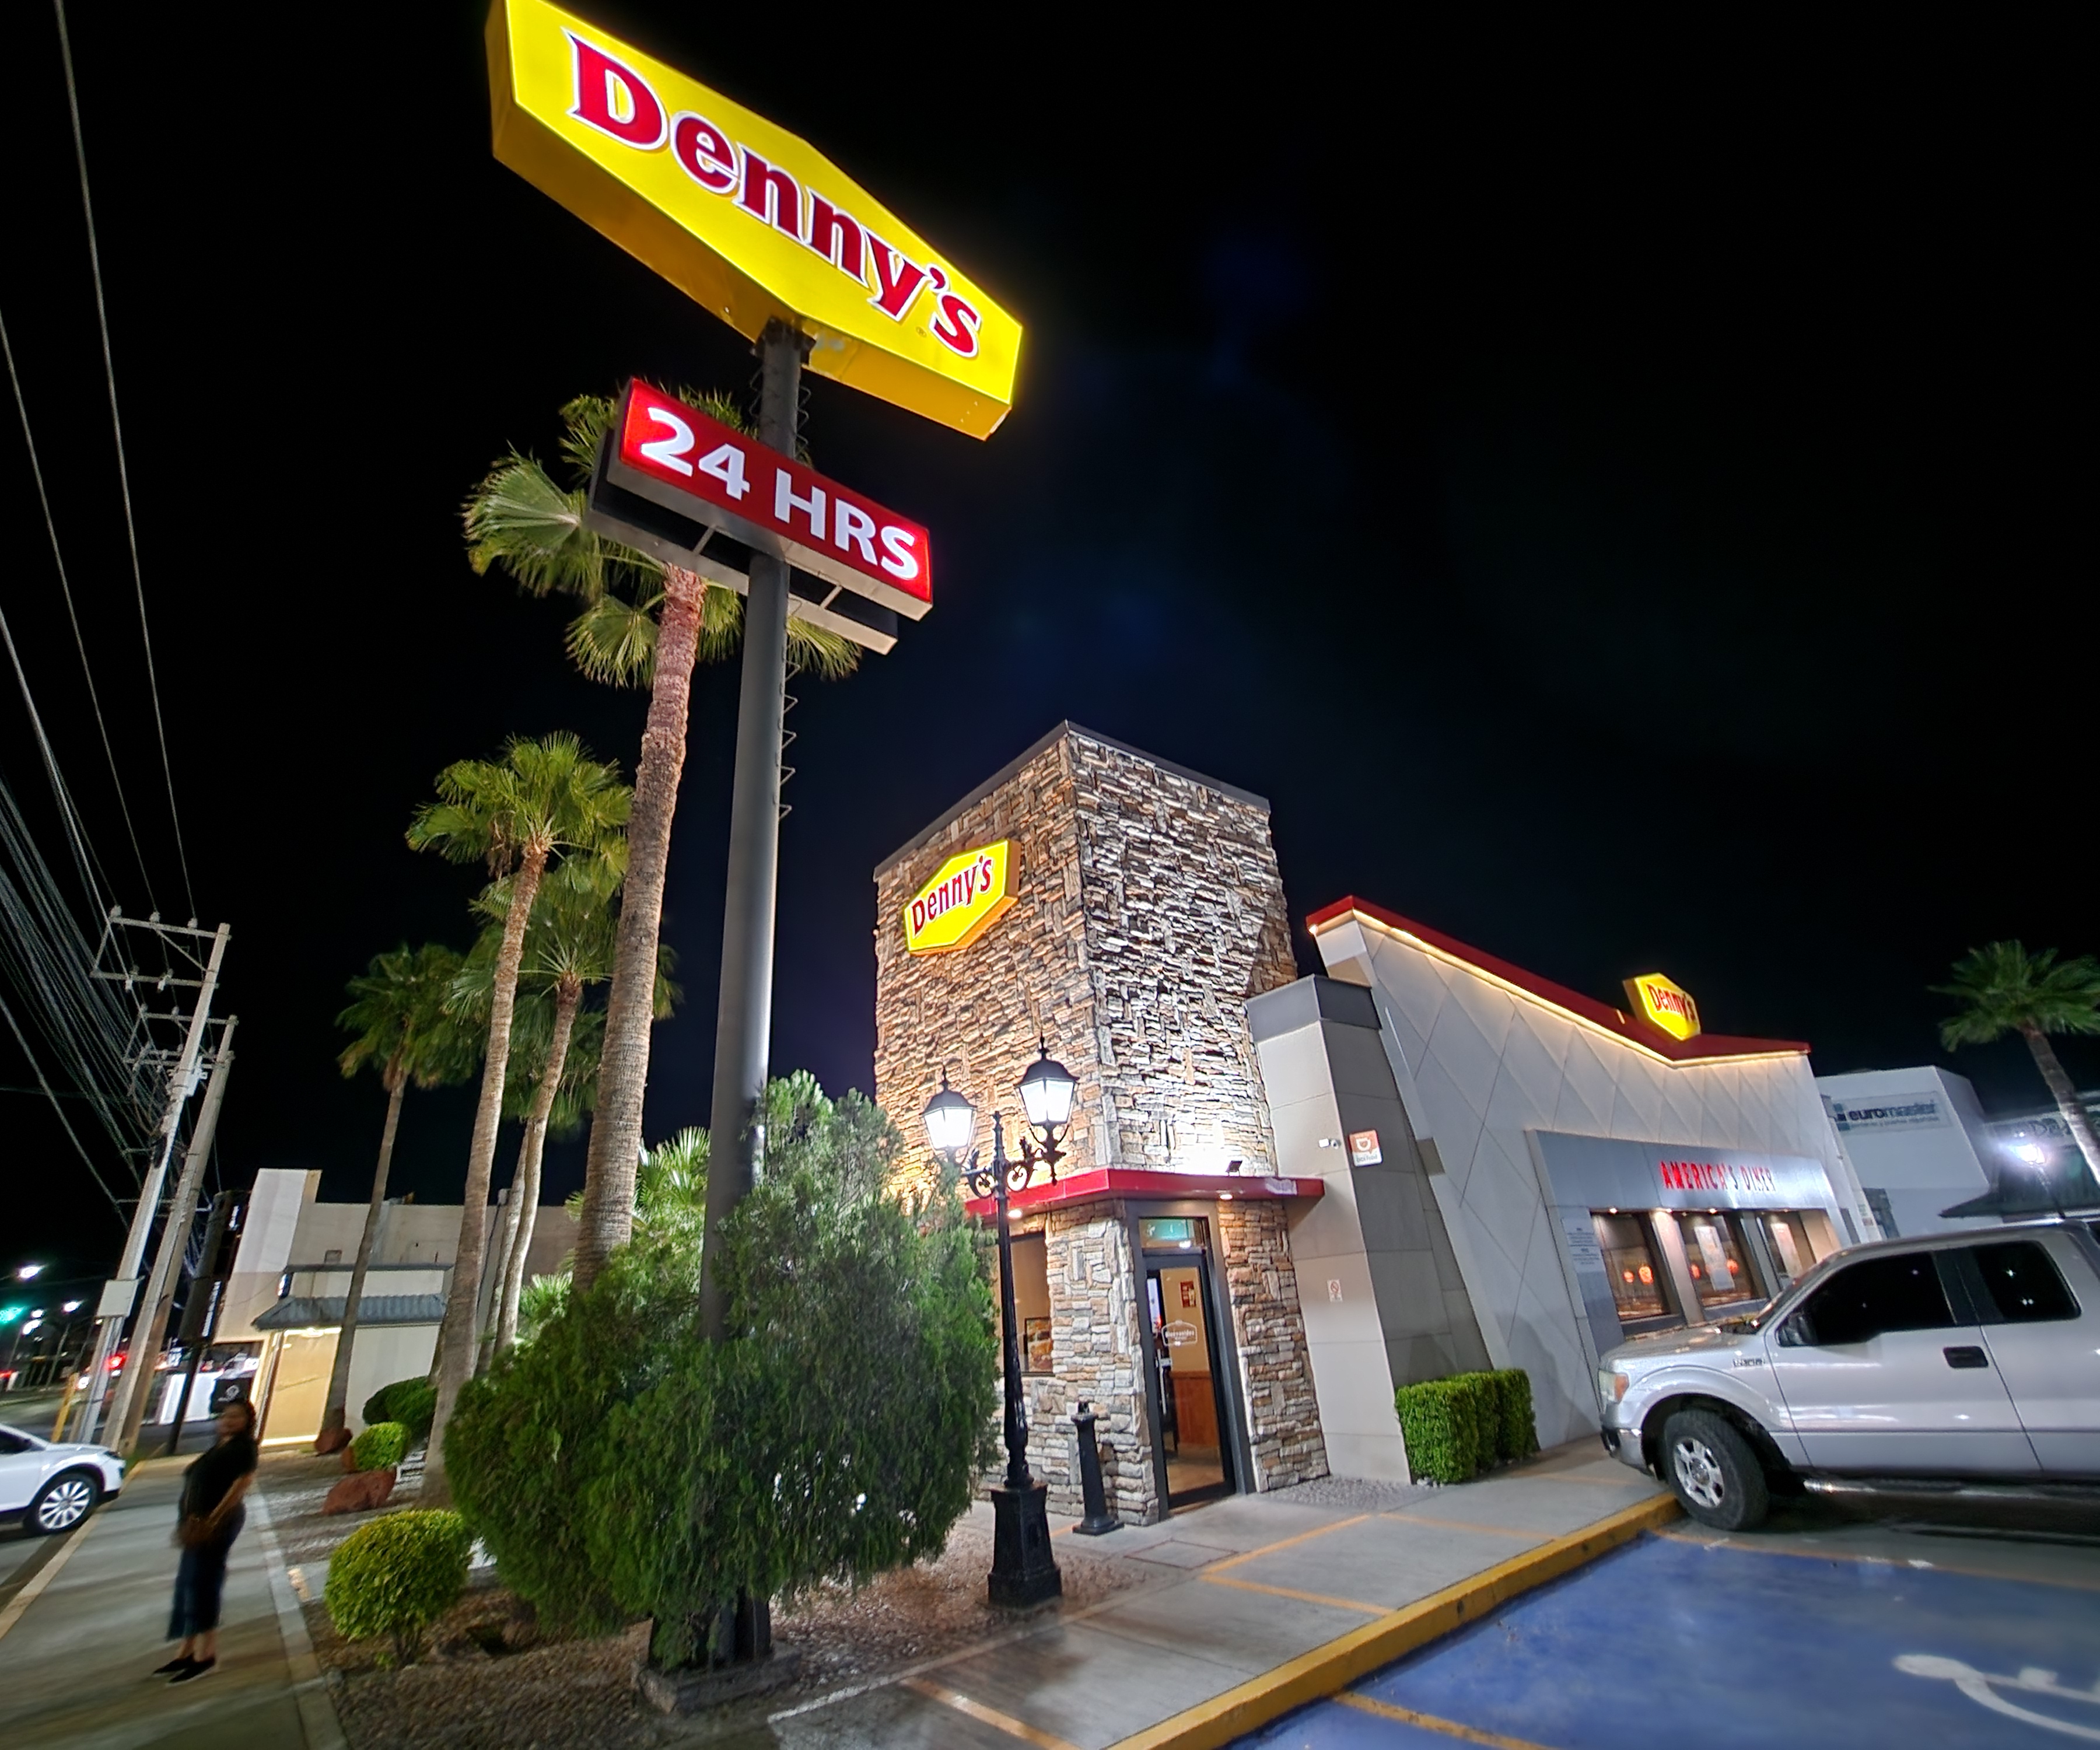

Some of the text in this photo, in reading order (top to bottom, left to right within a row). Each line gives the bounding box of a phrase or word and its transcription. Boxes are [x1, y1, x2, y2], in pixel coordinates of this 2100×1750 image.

[561, 26, 982, 357] Denny's
[640, 407, 919, 580] 24 HRS
[911, 855, 992, 936] Denny's
[1646, 984, 1696, 1022] Denny's
[1660, 1161, 1738, 1190] AMERICA'S
